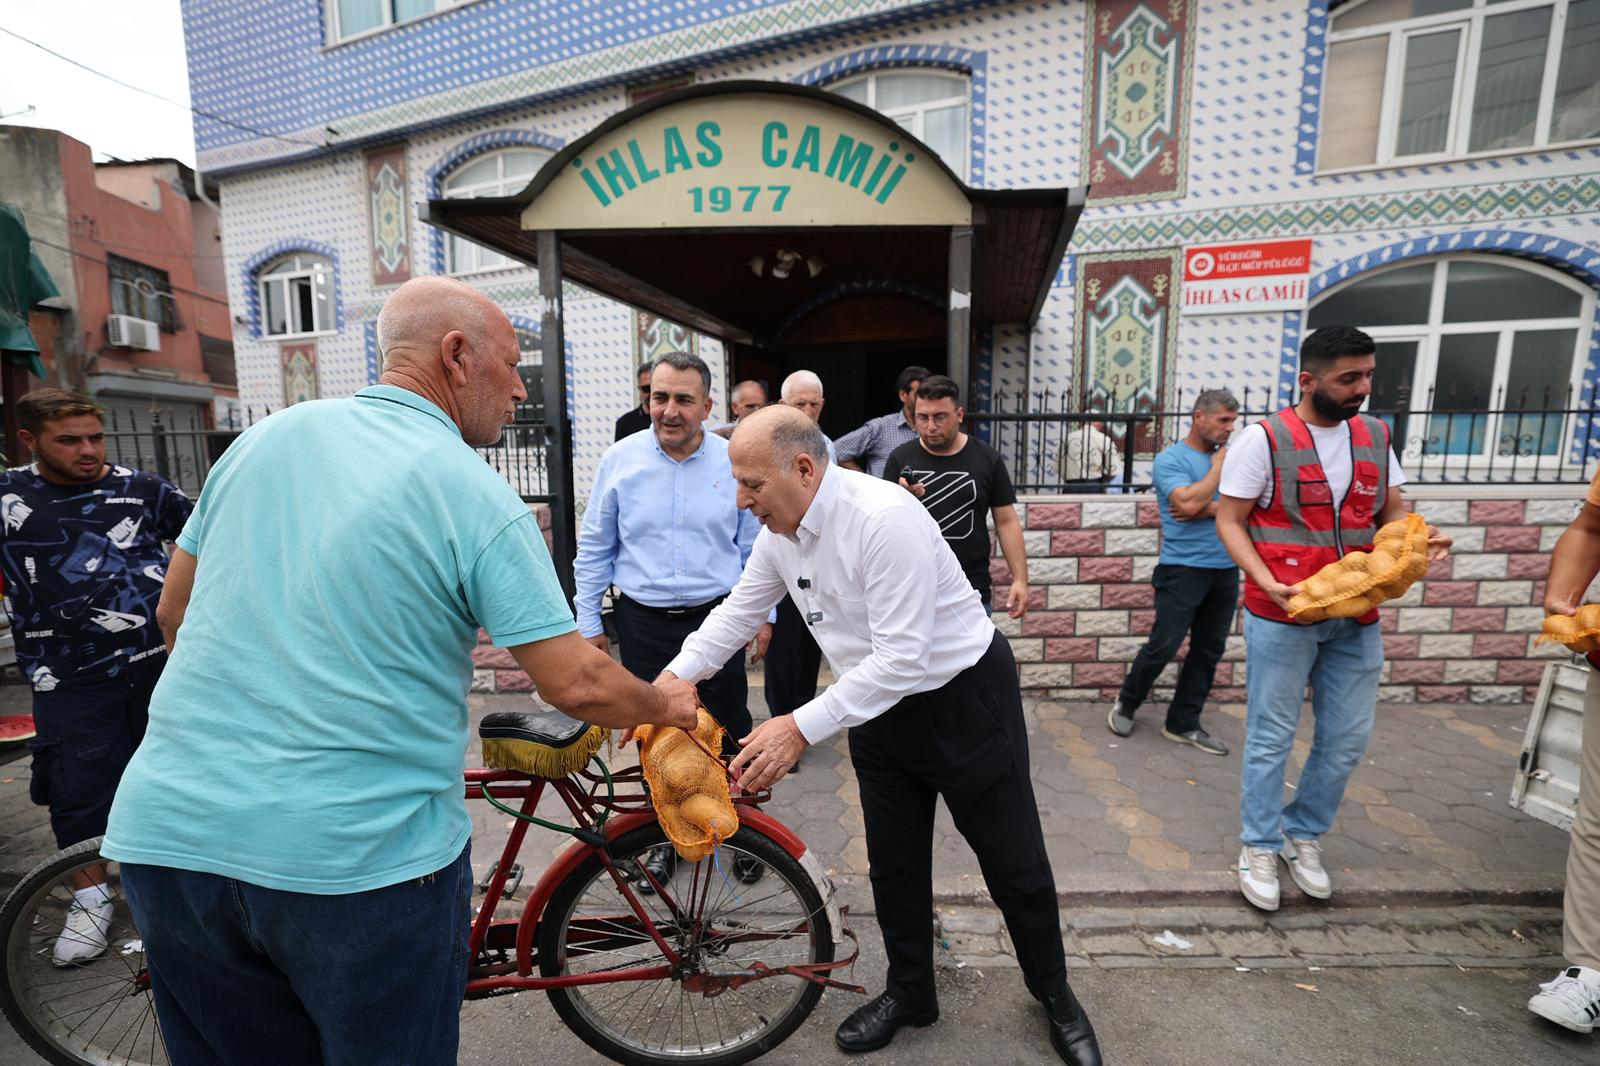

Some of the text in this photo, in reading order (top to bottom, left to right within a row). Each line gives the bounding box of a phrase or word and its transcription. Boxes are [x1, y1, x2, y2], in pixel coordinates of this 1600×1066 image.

[572, 121, 915, 207] İHLAS CAMİİ
[687, 186, 791, 213] 1977
[1186, 280, 1305, 305] İHLAS CAMİİ
